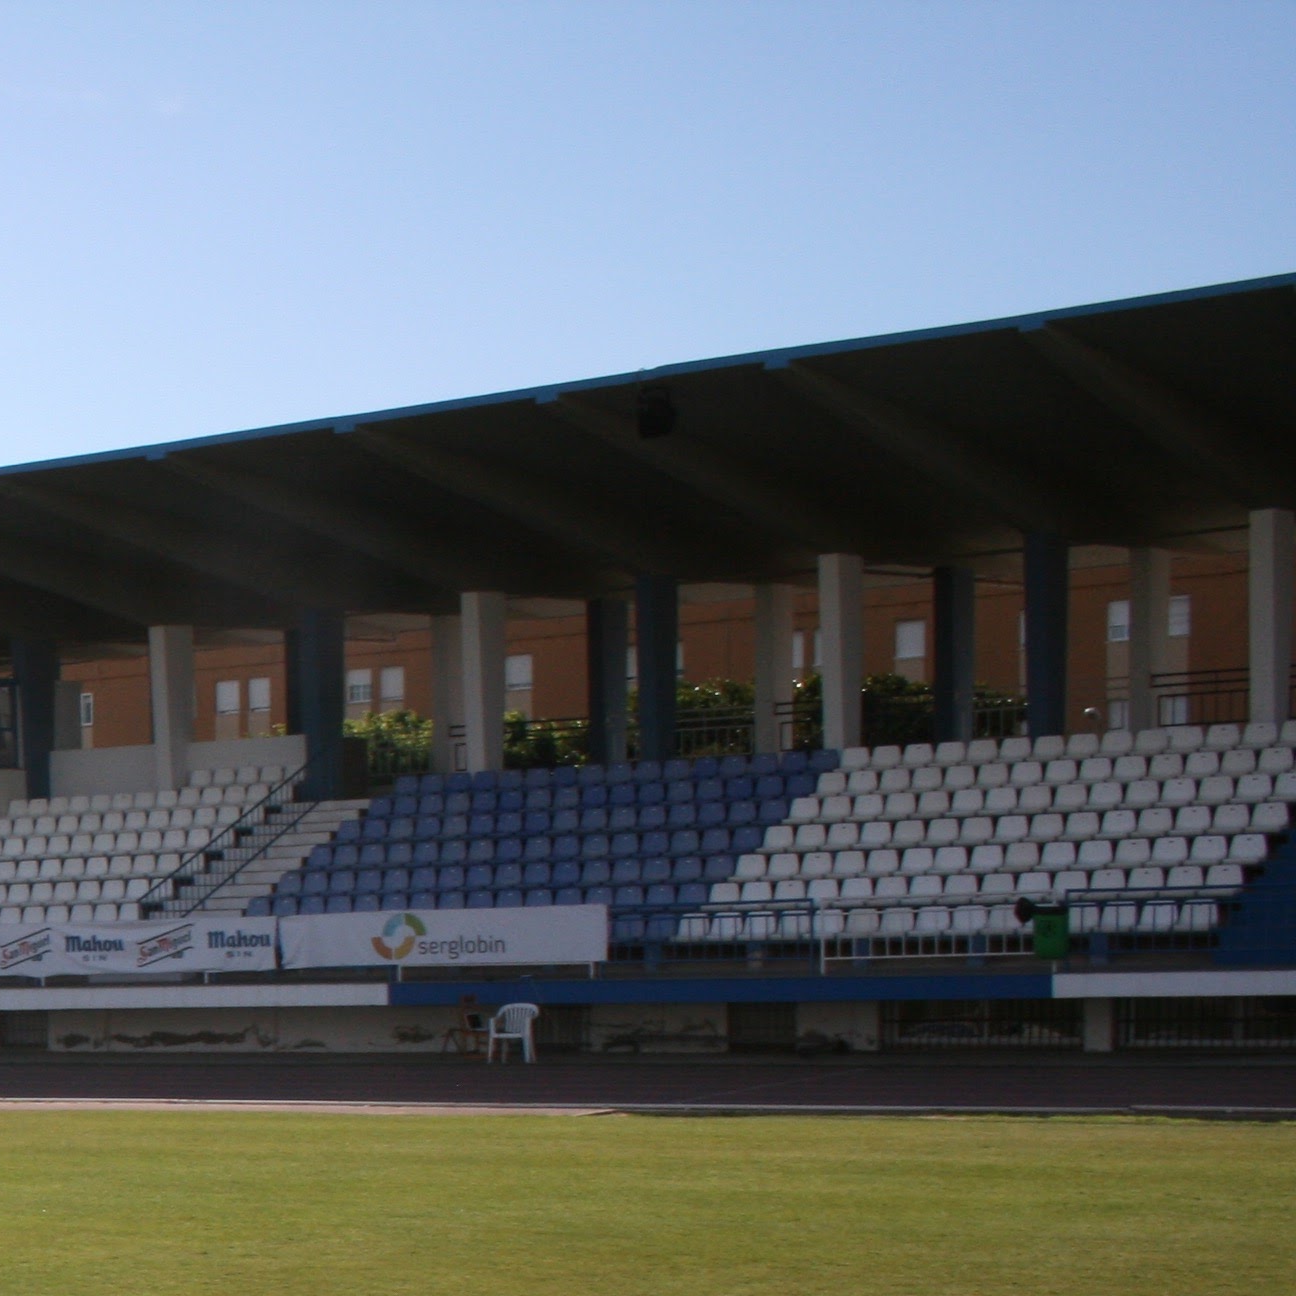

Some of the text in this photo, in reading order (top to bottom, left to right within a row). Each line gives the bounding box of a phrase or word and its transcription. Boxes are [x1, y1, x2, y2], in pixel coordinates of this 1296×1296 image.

[65, 935, 124, 952] Mahou
[207, 930, 271, 949] Mahou
[418, 935, 506, 960] serglobin
